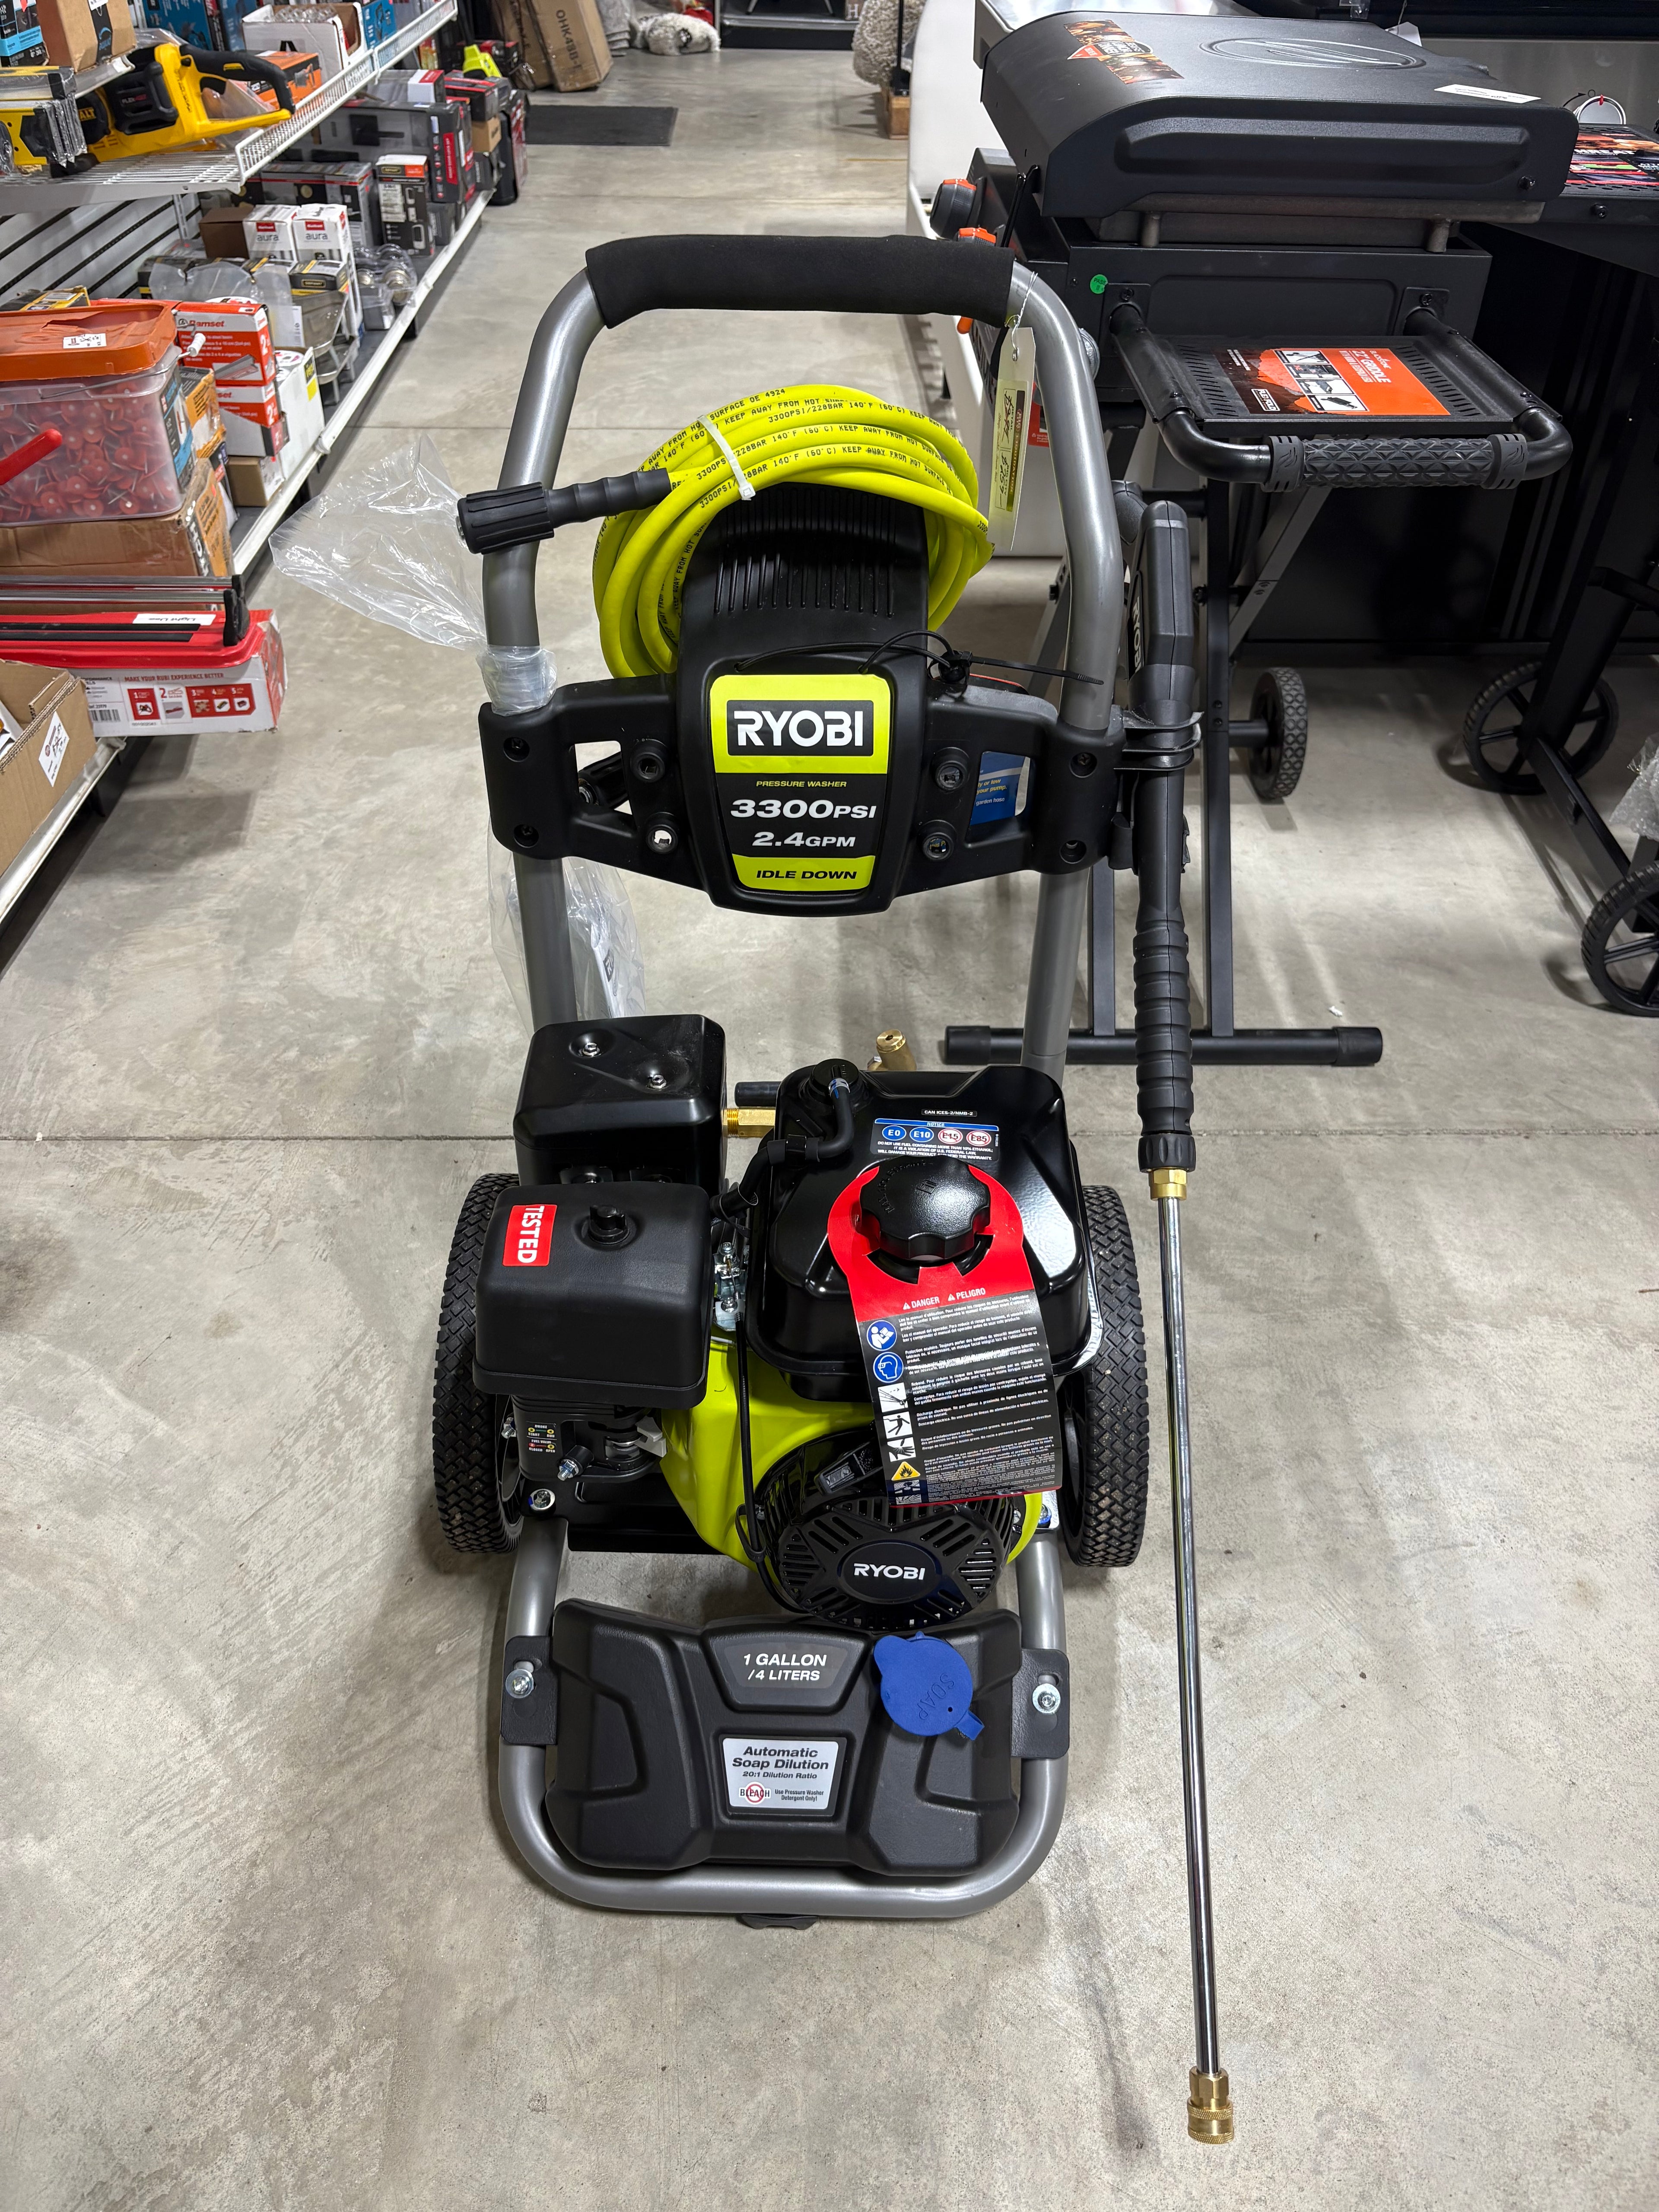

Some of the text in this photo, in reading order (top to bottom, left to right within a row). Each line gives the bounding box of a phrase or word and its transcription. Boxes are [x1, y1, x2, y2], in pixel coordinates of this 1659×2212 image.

[1360, 359, 1392, 383] GRIDDLE
[725, 412, 745, 425] KEEP
[752, 404, 772, 415] AWAY
[778, 398, 799, 408] FROM
[768, 402, 843, 423] 3300PSI/228BAR
[909, 410, 925, 420] KEEP
[648, 448, 664, 465] AWAY
[668, 431, 687, 446] FROM
[691, 422, 701, 431] HO
[710, 400, 745, 420] SURFACE
[766, 388, 785, 397] 4924
[864, 426, 881, 435] AWAY
[886, 430, 903, 441] FROM
[907, 437, 918, 446] HOT
[866, 447, 885, 456] AWAY
[890, 451, 906, 463] FROM
[910, 458, 921, 467] HOT
[676, 556, 687, 574] FROM
[683, 540, 695, 553] HOT
[1133, 596, 1141, 673] RYOBI
[734, 710, 863, 747] RYOBI
[990, 785, 1007, 793] pump.
[731, 799, 877, 819] 3300PSI
[752, 832, 855, 847] 2.4GPM
[756, 870, 857, 880] IDLE DOWN
[517, 1205, 545, 1263] TESTED
[911, 1287, 986, 1308] DANGER PELIGRO
[854, 1563, 925, 1580] RYOBI
[744, 1654, 827, 1666] 1 GALLON
[769, 1670, 820, 1681] LITERS
[919, 1672, 955, 1720] SOAP
[743, 1746, 818, 1758] Automatic
[732, 1758, 829, 1770] Soap Dilution
[740, 1789, 770, 1797] BLEACH
